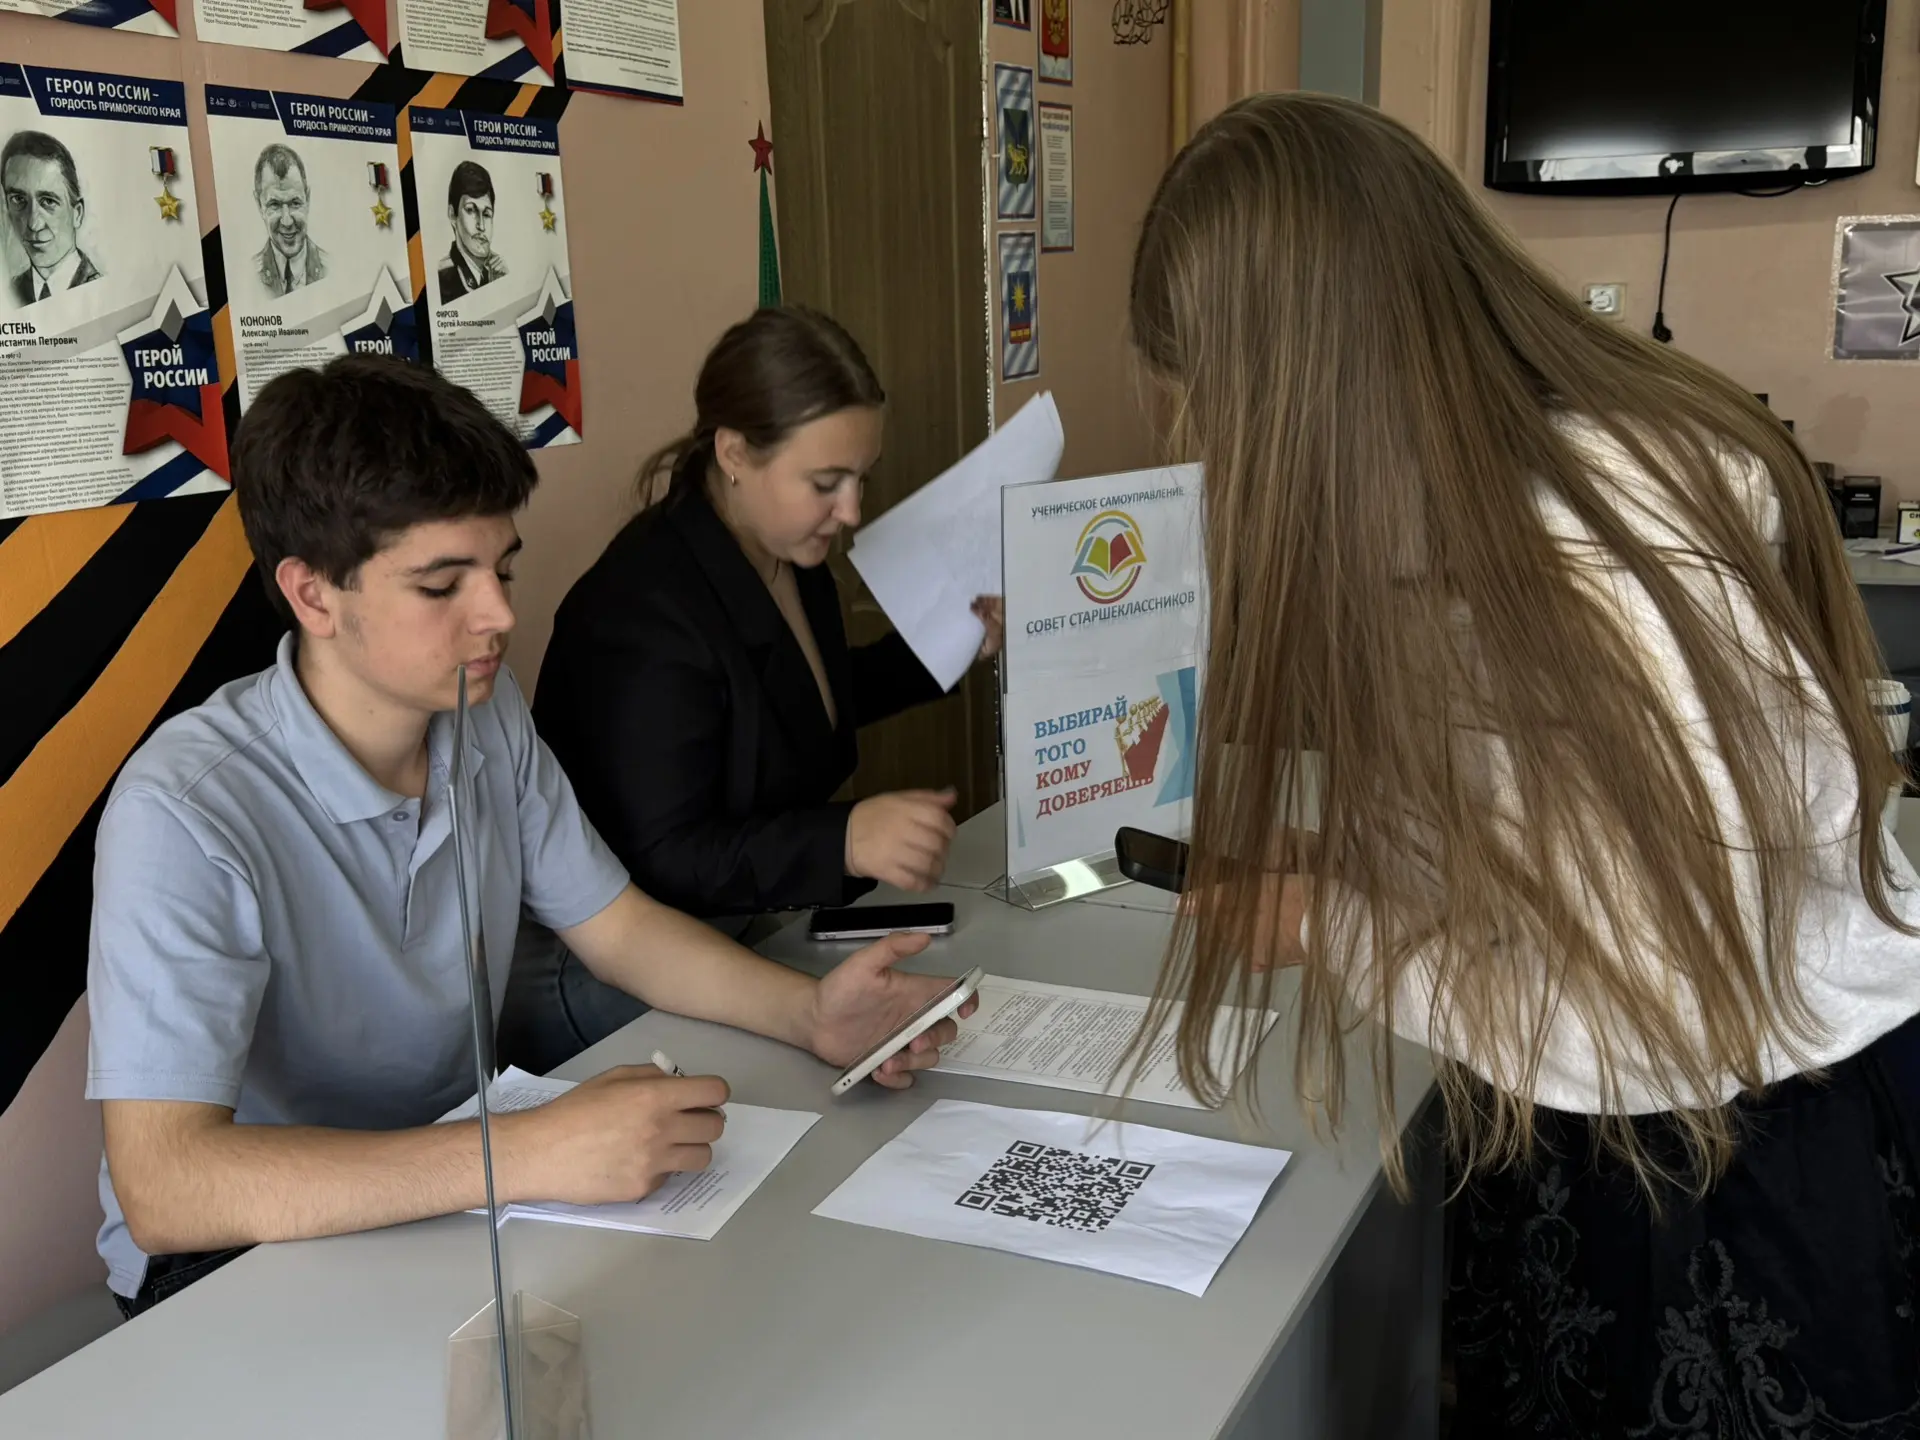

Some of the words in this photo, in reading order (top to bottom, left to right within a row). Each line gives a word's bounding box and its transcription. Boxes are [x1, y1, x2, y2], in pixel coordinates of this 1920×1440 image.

[45, 77, 94, 95] ГЕРОИ
[98, 82, 150, 101] РОССИИ
[50, 97, 97, 111] ГОРДОСТЬ
[98, 101, 158, 116] ПРИМОРСКОГО
[160, 108, 181, 118] КРАЯ
[290, 102, 326, 118] ГЕРОИ
[328, 106, 369, 122] РОССИИ
[293, 119, 328, 131] ГОРДОСТЬ
[328, 123, 374, 135] ПРИМОРСКОГО
[375, 128, 392, 137] КРАЯ
[473, 119, 501, 133] ГЕРОИ
[504, 122, 537, 137] РОССИИ
[475, 135, 503, 145] ГОРДОСТЬ
[503, 137, 541, 149] ПРИМОРСКОГО
[541, 141, 556, 150] КРАЯ
[240, 315, 282, 326] КОНОНОВ
[436, 310, 459, 318] ФИРСОВ
[436, 320, 456, 328] Сергей
[456, 319, 496, 328] Александрович
[38, 335, 78, 348] Петрович
[241, 329, 278, 338] Александр
[278, 328, 310, 336] Иванович
[526, 327, 556, 346] ГЕРОЙ
[354, 336, 393, 355] ГЕРОЙ
[532, 347, 571, 362] РОССИИ
[134, 343, 184, 368] ГЕРОЙ
[143, 367, 209, 389] РОССИИ
[1031, 498, 1098, 518] УЧЕНИЧЕСКОЕ
[1099, 486, 1185, 508] САМОУПРАВЛЕНИЕ
[1026, 615, 1067, 635] СОВЕТ
[1069, 590, 1195, 627] СТАРШЕКЛАССНИКОВ
[1034, 695, 1128, 739] ВЫБИРАЙ
[1035, 738, 1087, 765] ТОГО
[1035, 759, 1092, 790] КОМУ
